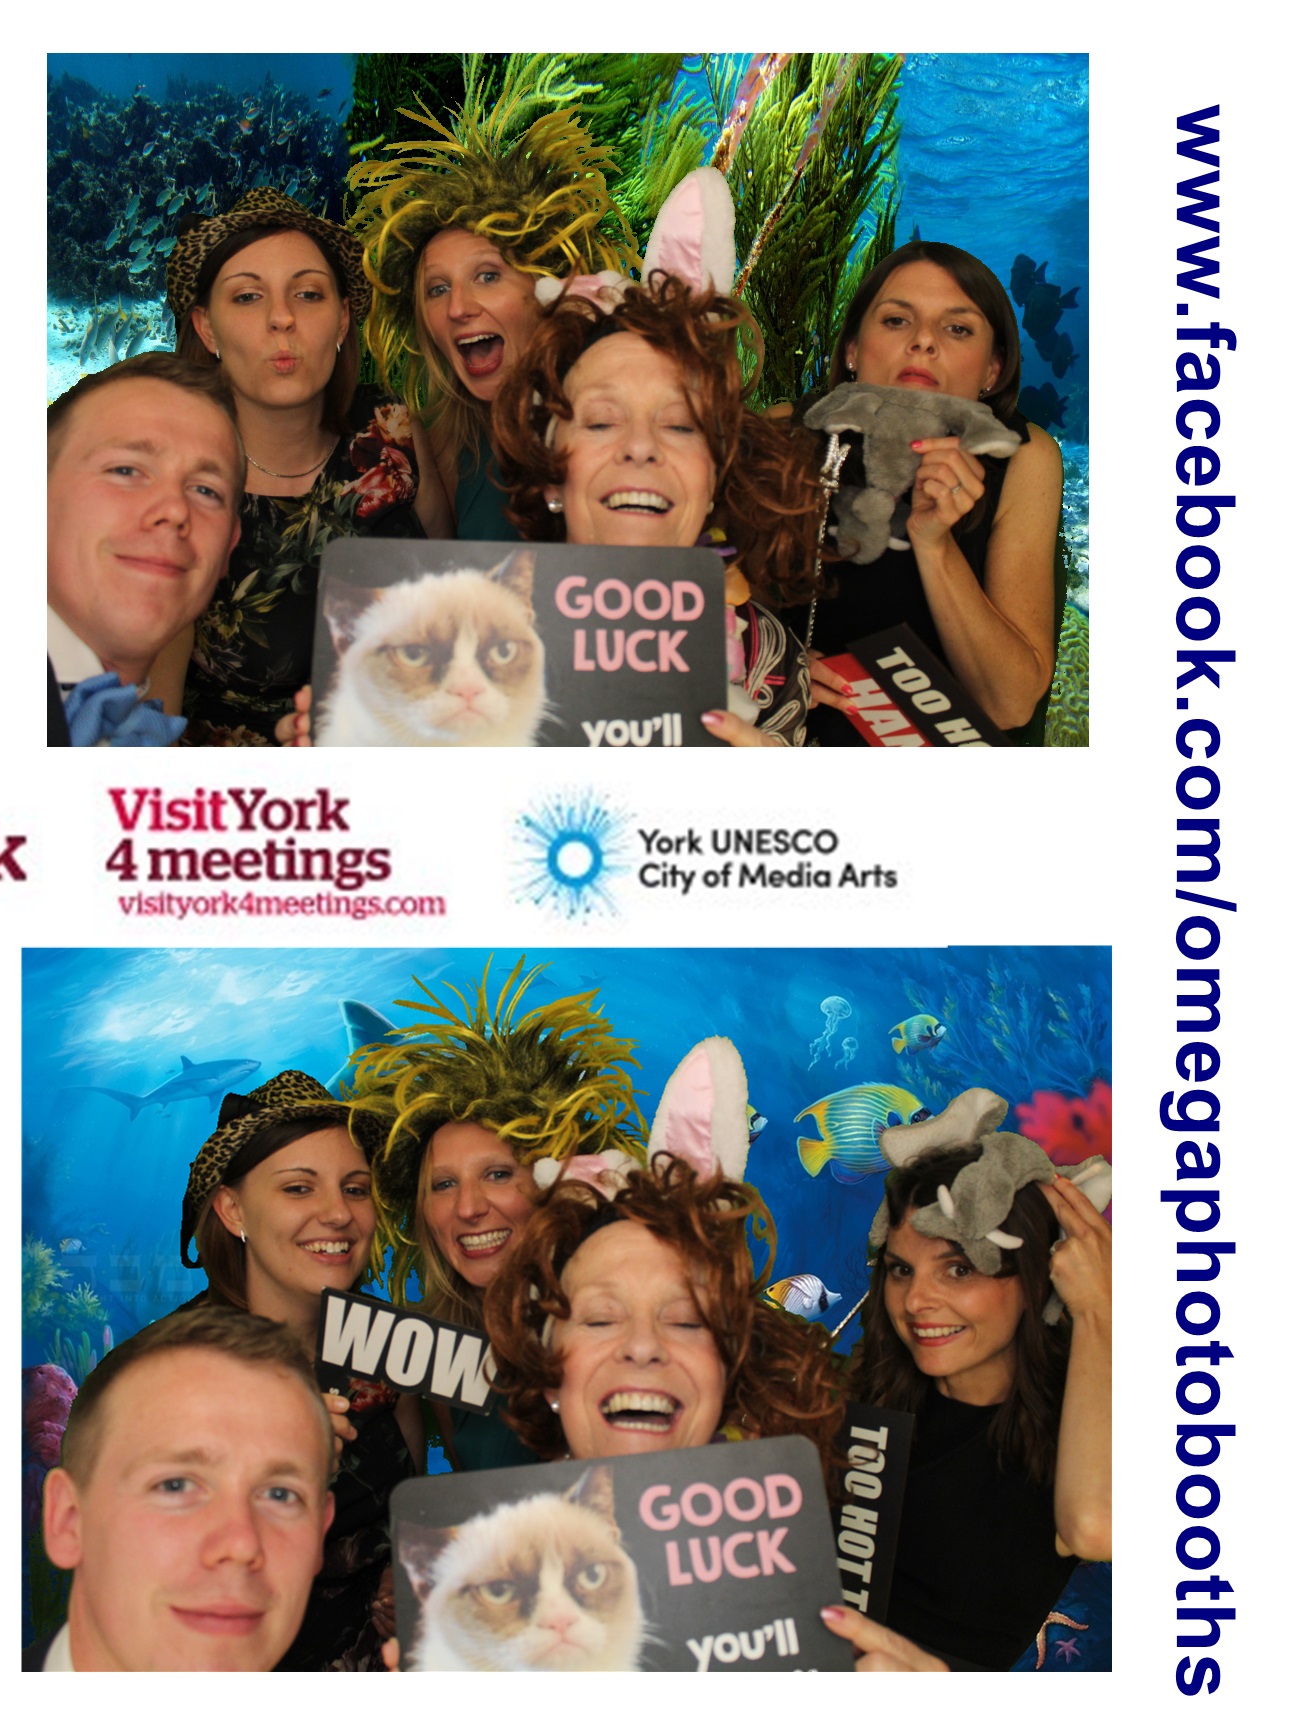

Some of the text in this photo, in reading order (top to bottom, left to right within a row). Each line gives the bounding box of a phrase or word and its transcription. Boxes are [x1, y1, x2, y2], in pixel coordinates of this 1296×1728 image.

[555, 575, 705, 621] GOOD
[574, 629, 690, 672] LUCK
[875, 646, 993, 747] TOO H
[581, 713, 682, 747] you'll
[322, 1295, 498, 1407] WOW
[639, 1474, 803, 1531] GOOD
[837, 1426, 889, 1613] TOO HOT T
[665, 1527, 797, 1586] LUCK
[686, 1617, 800, 1672] you'll
